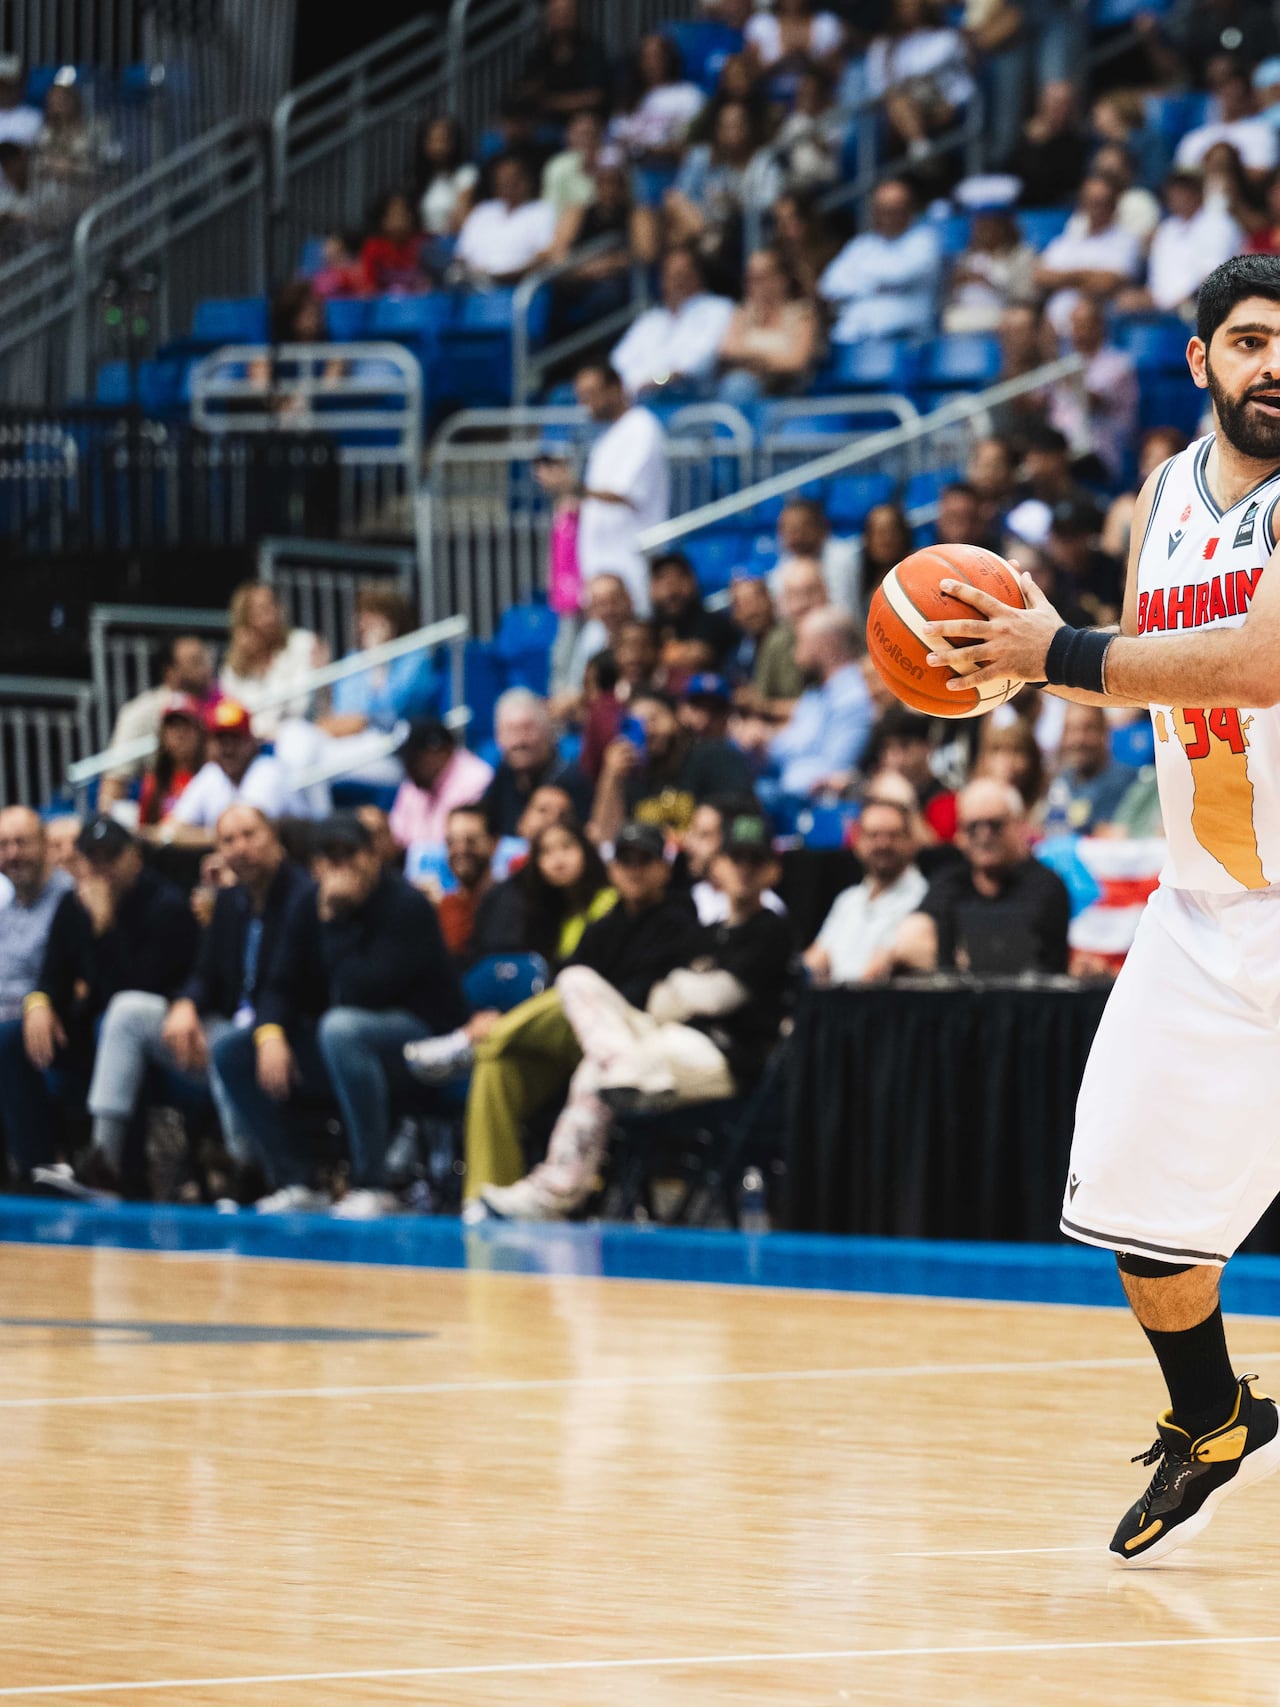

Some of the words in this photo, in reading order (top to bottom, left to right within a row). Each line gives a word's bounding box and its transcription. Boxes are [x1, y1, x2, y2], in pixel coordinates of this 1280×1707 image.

[1138, 568, 1263, 635] BAHRAIN
[874, 621, 924, 680] molten
[1183, 708, 1245, 760] 34
